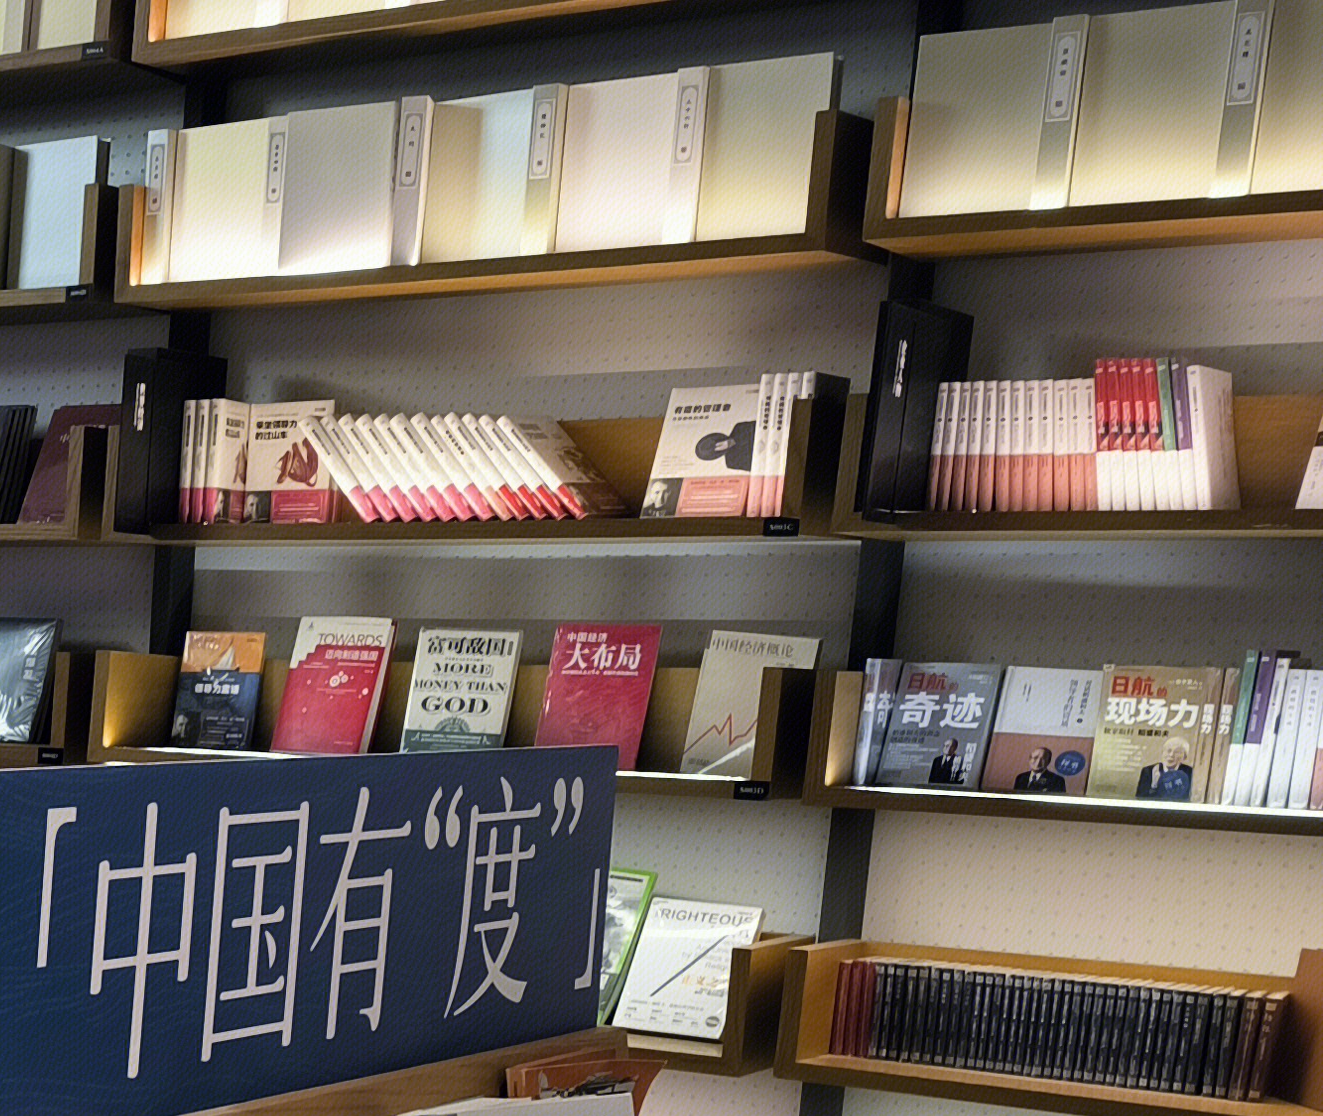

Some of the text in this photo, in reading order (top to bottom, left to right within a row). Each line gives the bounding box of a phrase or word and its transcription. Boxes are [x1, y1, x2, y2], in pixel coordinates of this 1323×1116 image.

[317, 633, 383, 647] TOWARDS
[561, 642, 642, 671] 大布局
[432, 662, 492, 677] MORE
[413, 679, 507, 694] MONEY THAN
[420, 695, 490, 715] GOD
[899, 692, 985, 729] 奇迹
[1106, 697, 1201, 728] 现场力
